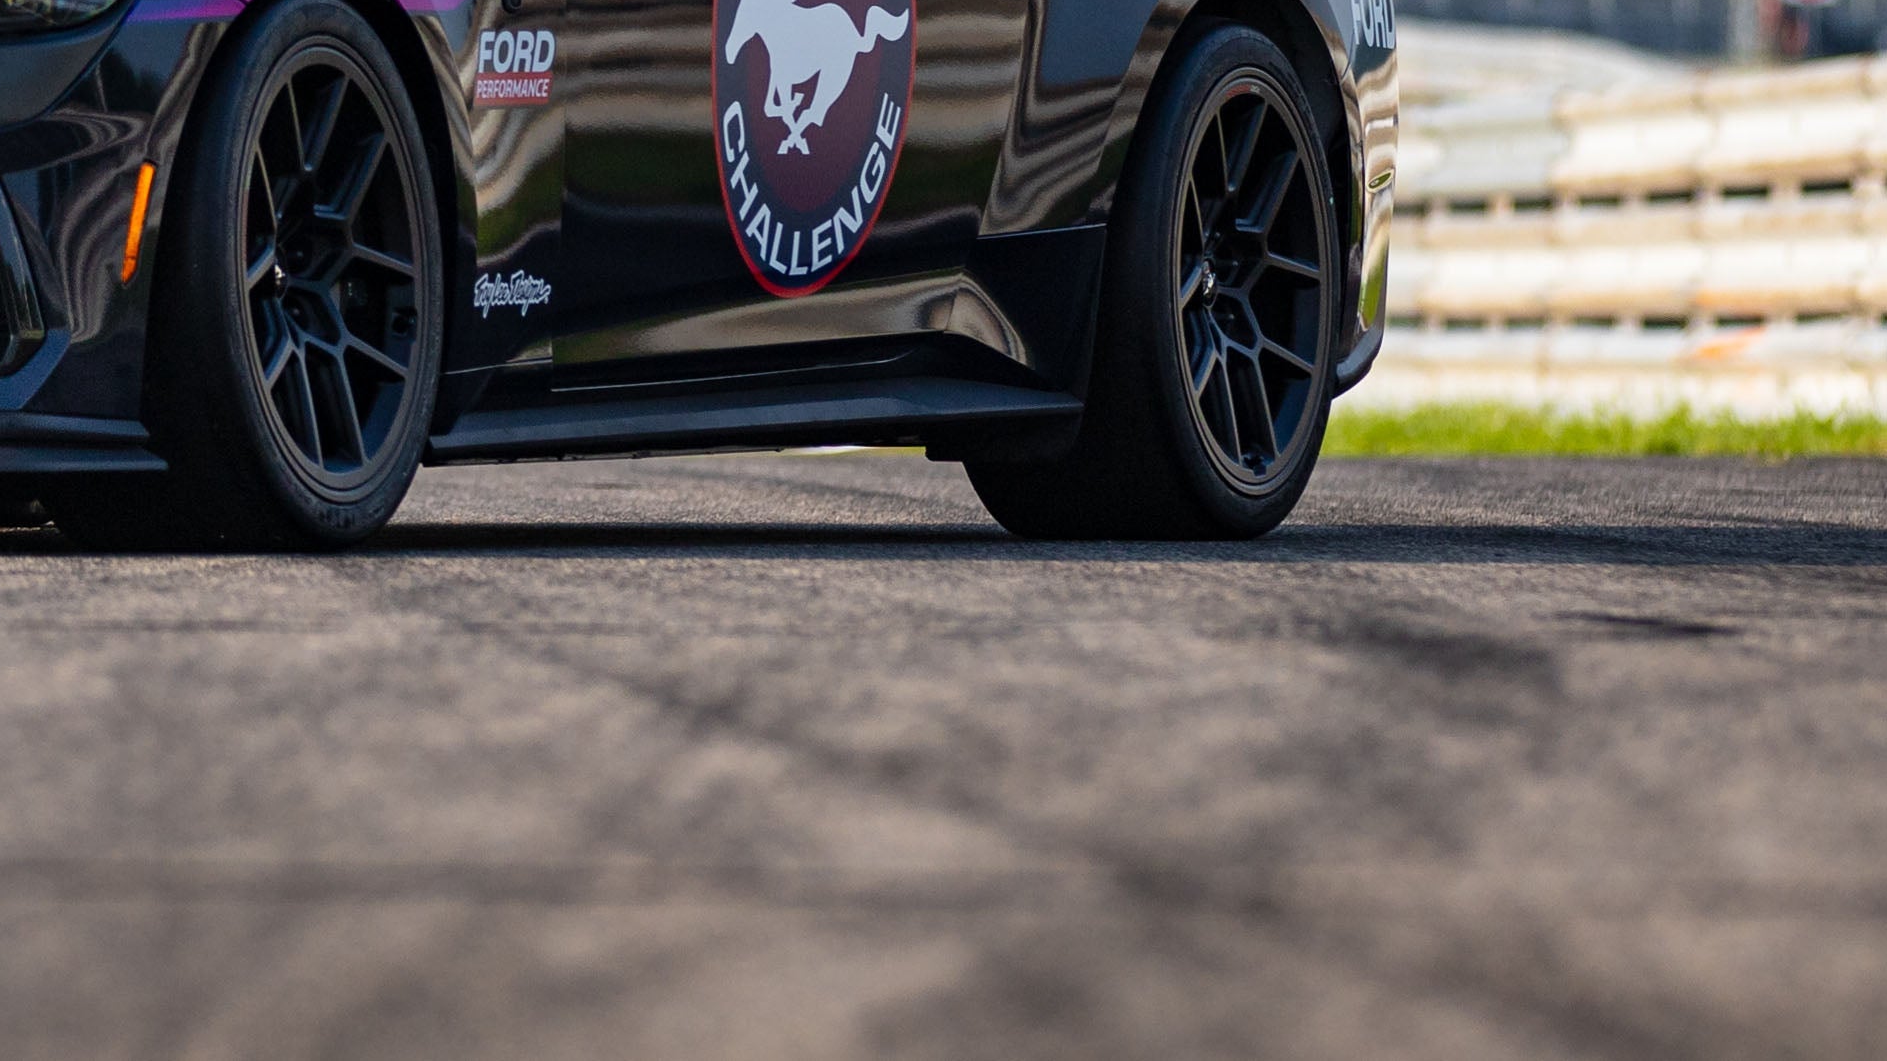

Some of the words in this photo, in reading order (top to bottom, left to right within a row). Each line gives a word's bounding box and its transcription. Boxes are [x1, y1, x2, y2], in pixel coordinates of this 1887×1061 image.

[478, 30, 555, 73] FORD
[476, 79, 550, 98] PERFORMANCE
[723, 92, 901, 276] CHALLENGE
